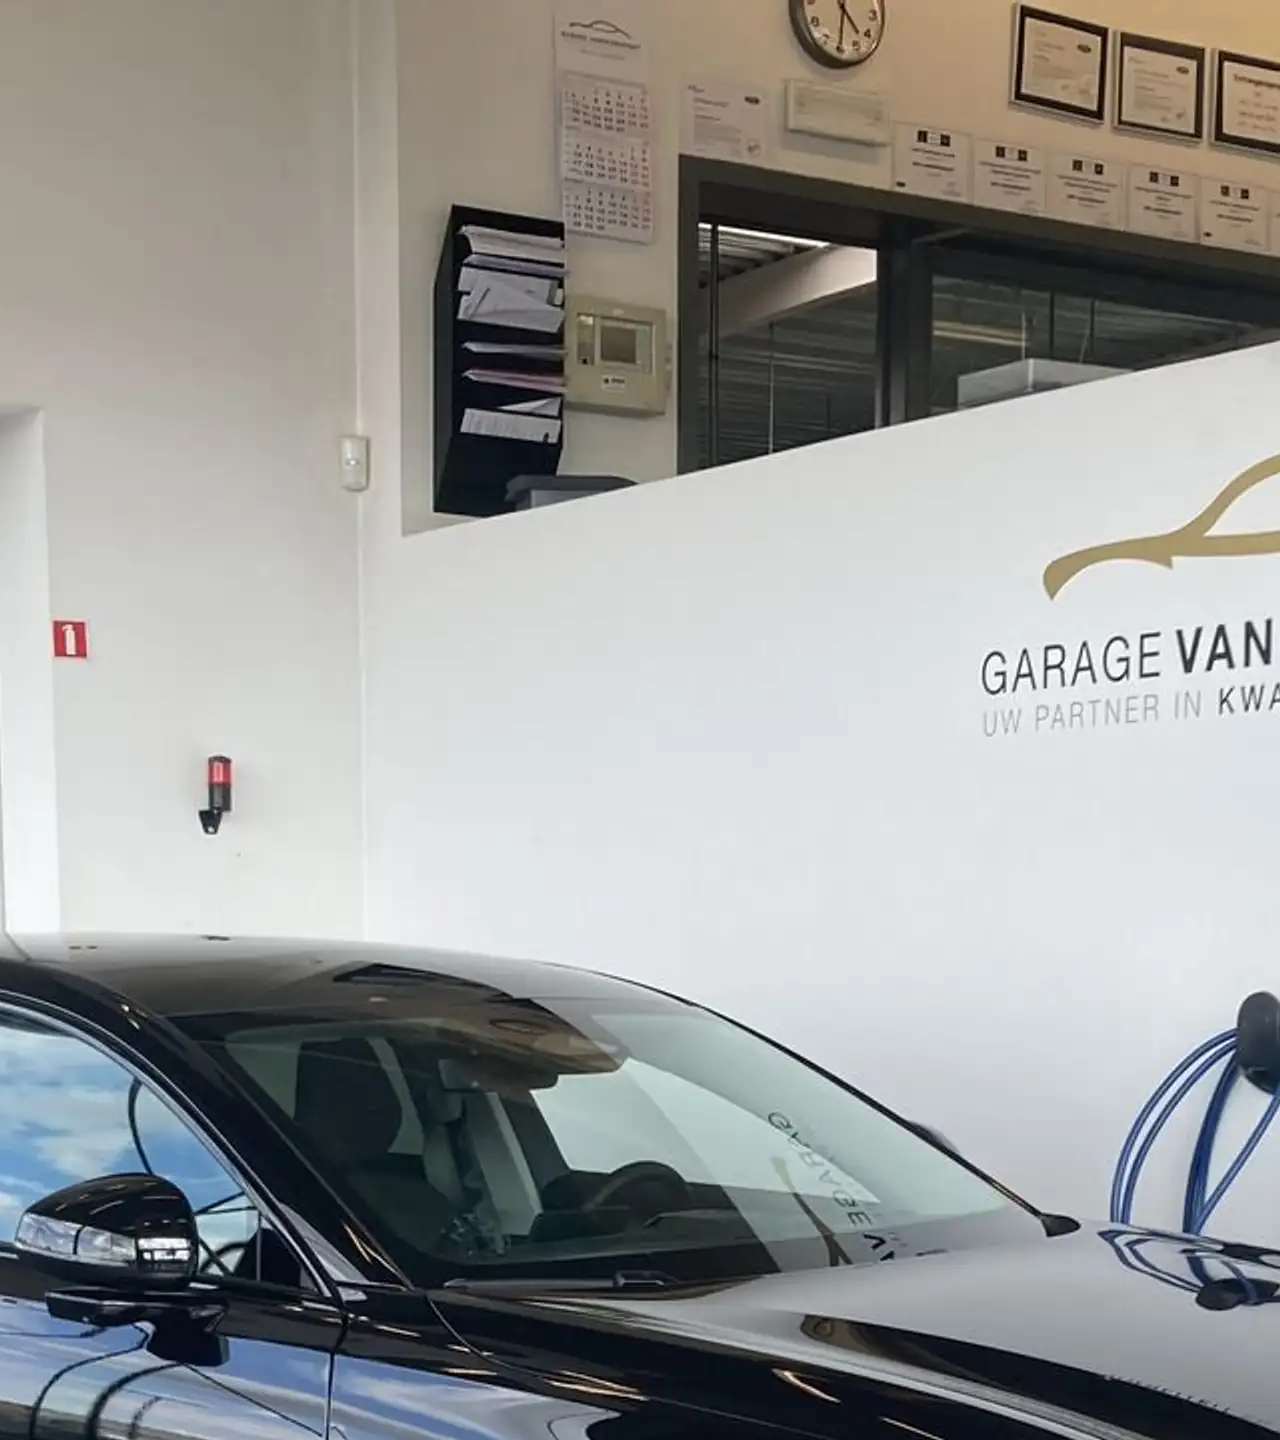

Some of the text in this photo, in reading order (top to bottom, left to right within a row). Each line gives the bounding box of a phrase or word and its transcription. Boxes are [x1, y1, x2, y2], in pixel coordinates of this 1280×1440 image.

[981, 631, 1161, 695] GARAGE
[982, 709, 1021, 737] UW
[1035, 695, 1160, 730] PARTNER
[1174, 692, 1201, 717] IN
